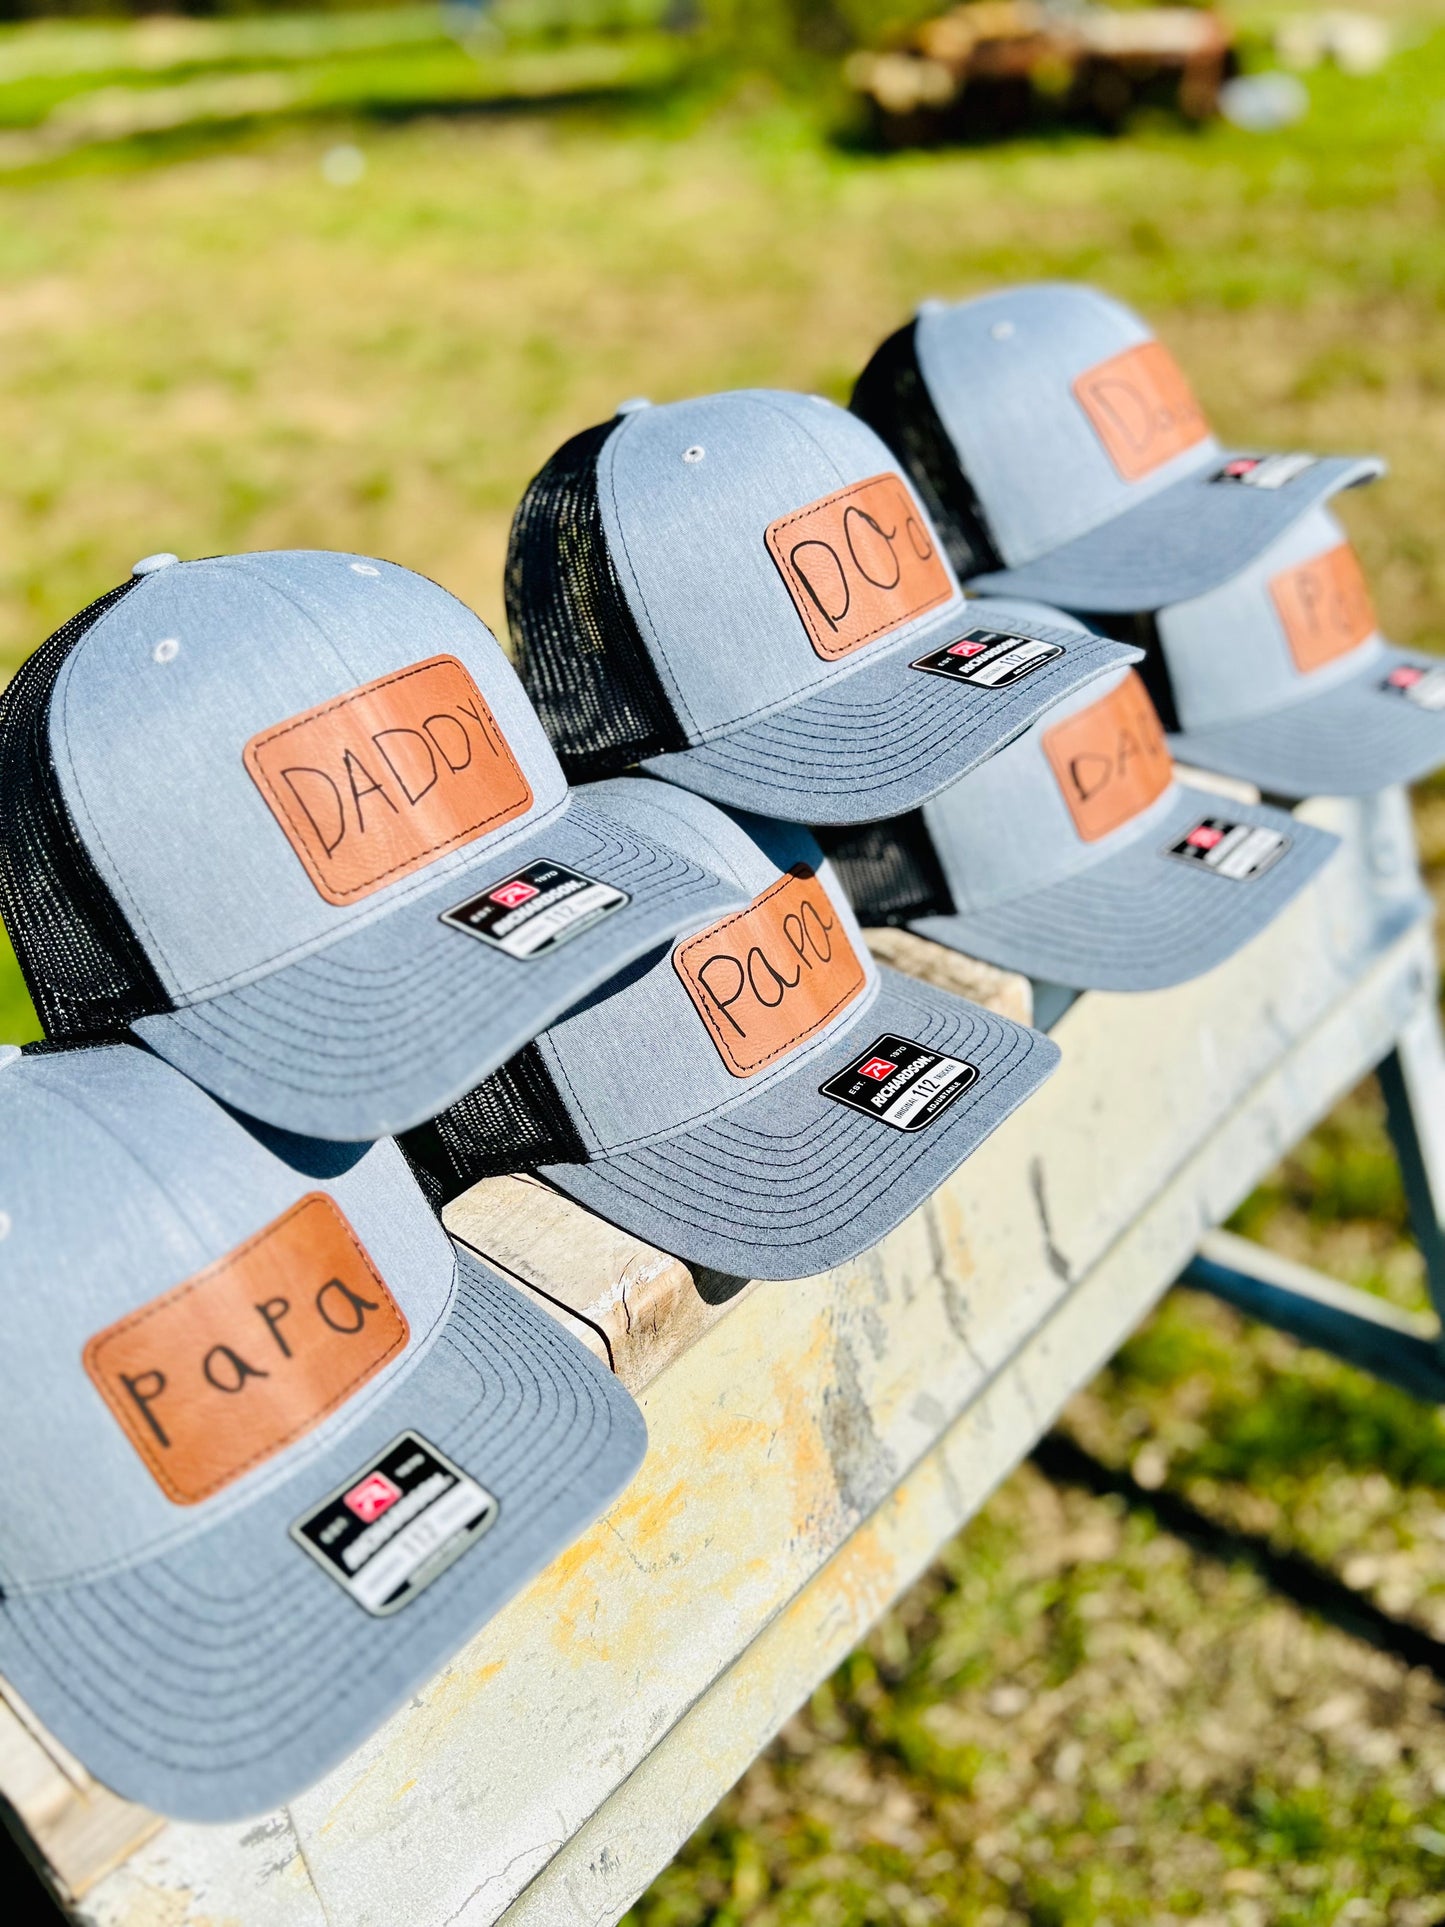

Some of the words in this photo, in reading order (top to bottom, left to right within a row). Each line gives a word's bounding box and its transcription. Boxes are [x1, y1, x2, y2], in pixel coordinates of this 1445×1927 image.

[1000, 654, 1027, 667] 112
[281, 698, 498, 860] DADDY
[848, 1081, 866, 1095] EST.
[890, 1046, 907, 1058] 1970
[894, 1097, 920, 1120] ORIGINAL
[912, 1079, 941, 1098] 112
[933, 1064, 956, 1080] TRUCKER
[926, 1081, 962, 1113] ADJUSTABLE
